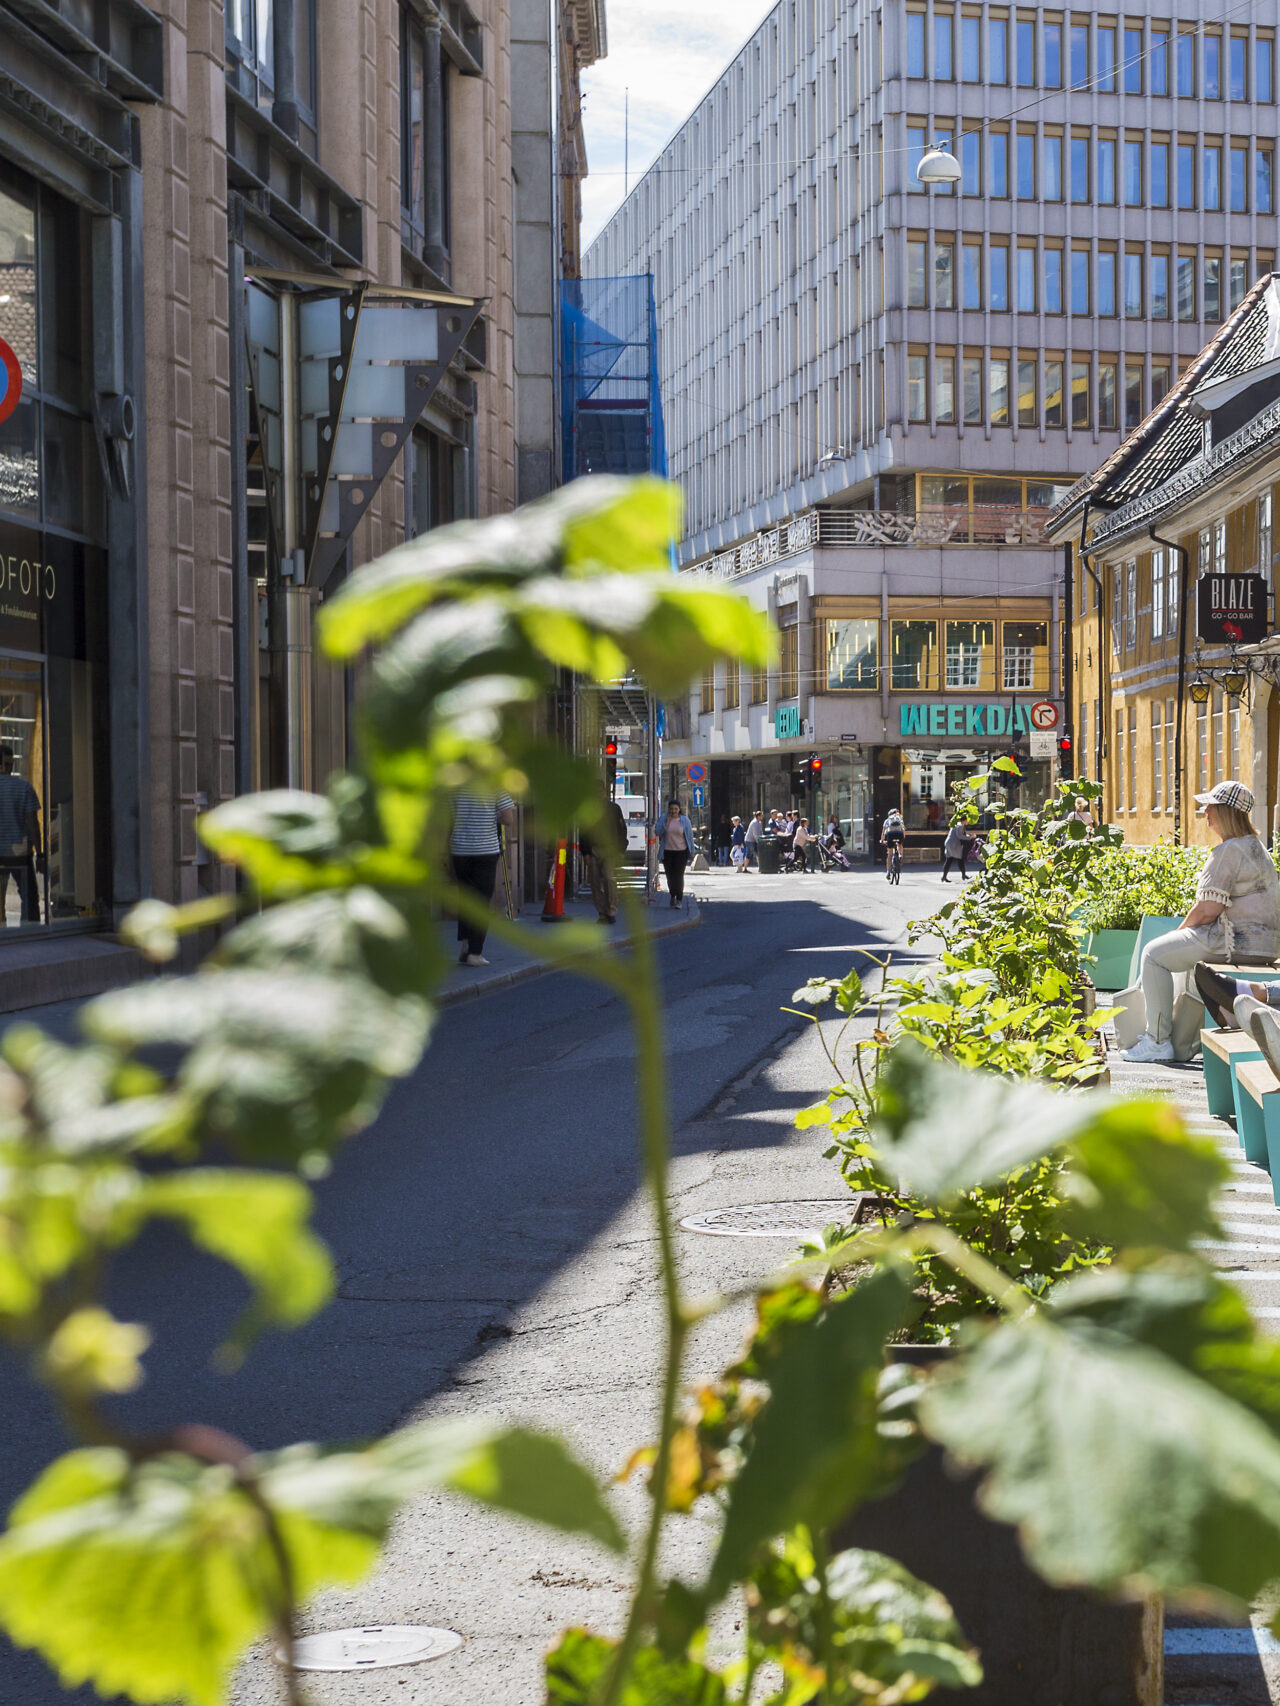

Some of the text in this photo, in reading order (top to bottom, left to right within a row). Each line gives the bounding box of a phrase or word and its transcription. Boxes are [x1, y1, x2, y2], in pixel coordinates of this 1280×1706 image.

[1211, 578, 1254, 610] BLAZE
[1239, 612, 1254, 620] BAR
[774, 705, 802, 739] WEEKDA
